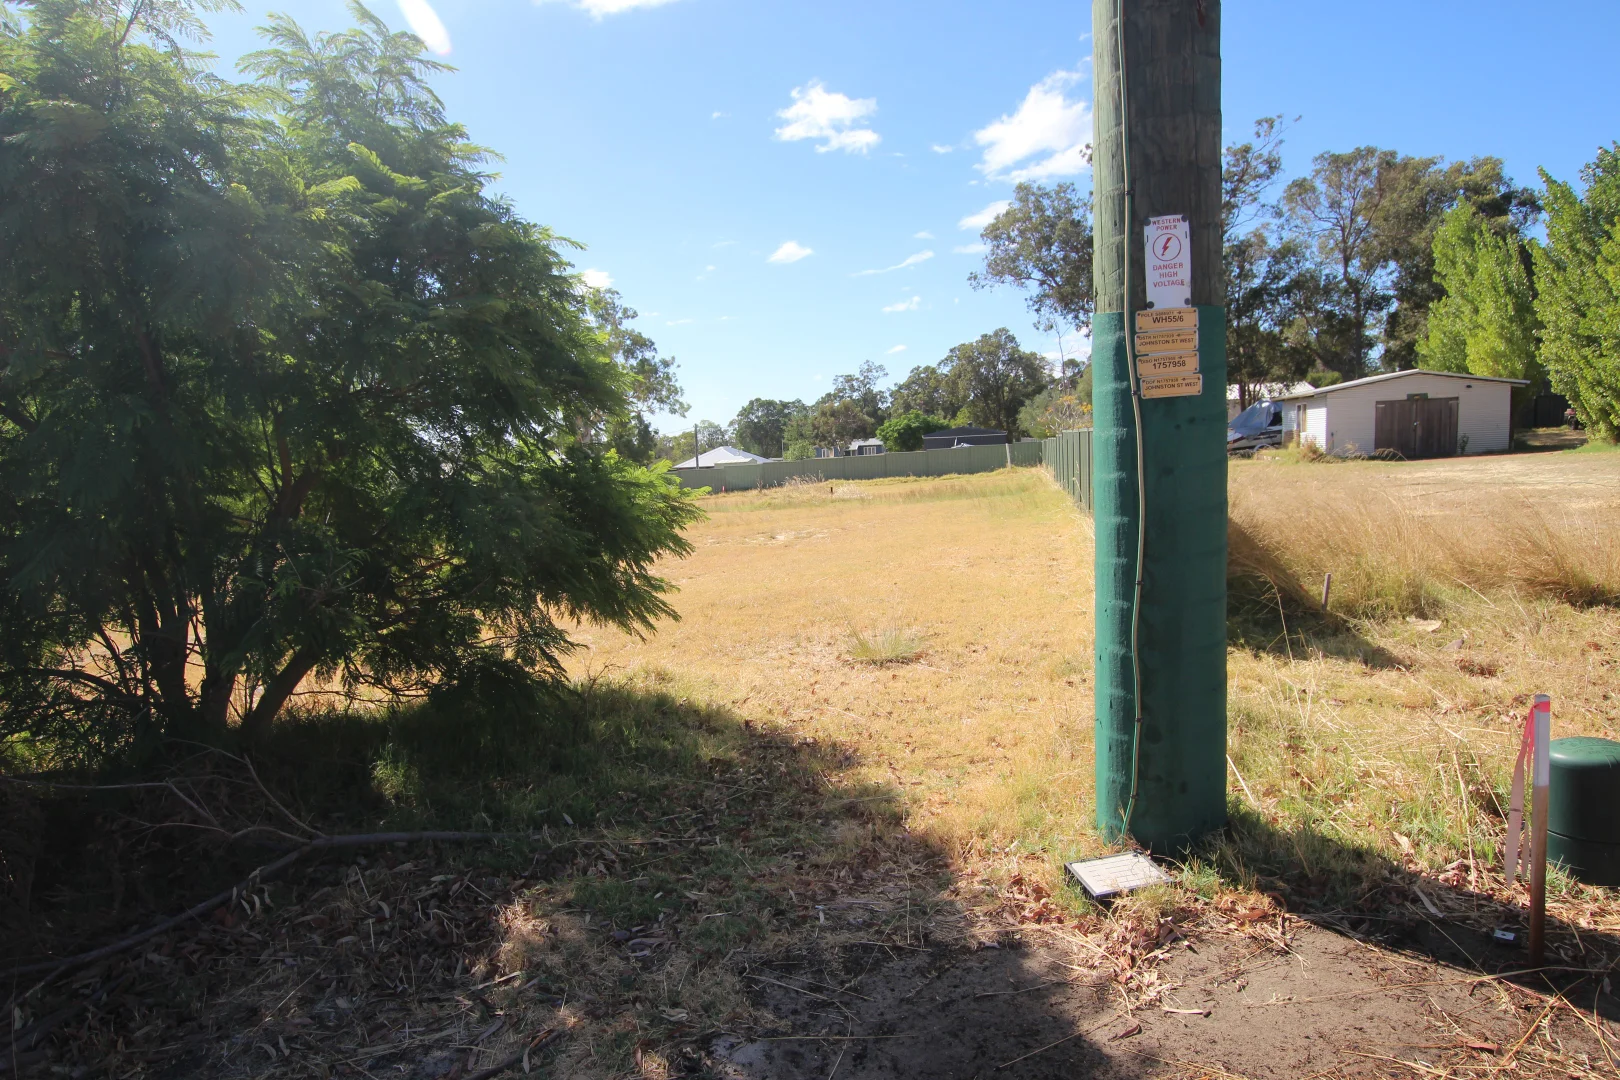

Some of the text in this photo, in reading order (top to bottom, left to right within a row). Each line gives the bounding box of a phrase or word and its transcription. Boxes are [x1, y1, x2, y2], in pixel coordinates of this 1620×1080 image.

[1152, 218, 1180, 226] WESTERN
[1153, 262, 1183, 271] DANGER
[1153, 279, 1185, 288] VOLTAGE
[1152, 315, 1184, 324] WH55/6
[1139, 339, 1170, 347] JOHNSTON
[1152, 360, 1186, 369] 1757958
[1145, 383, 1175, 391] JOHNSTON
